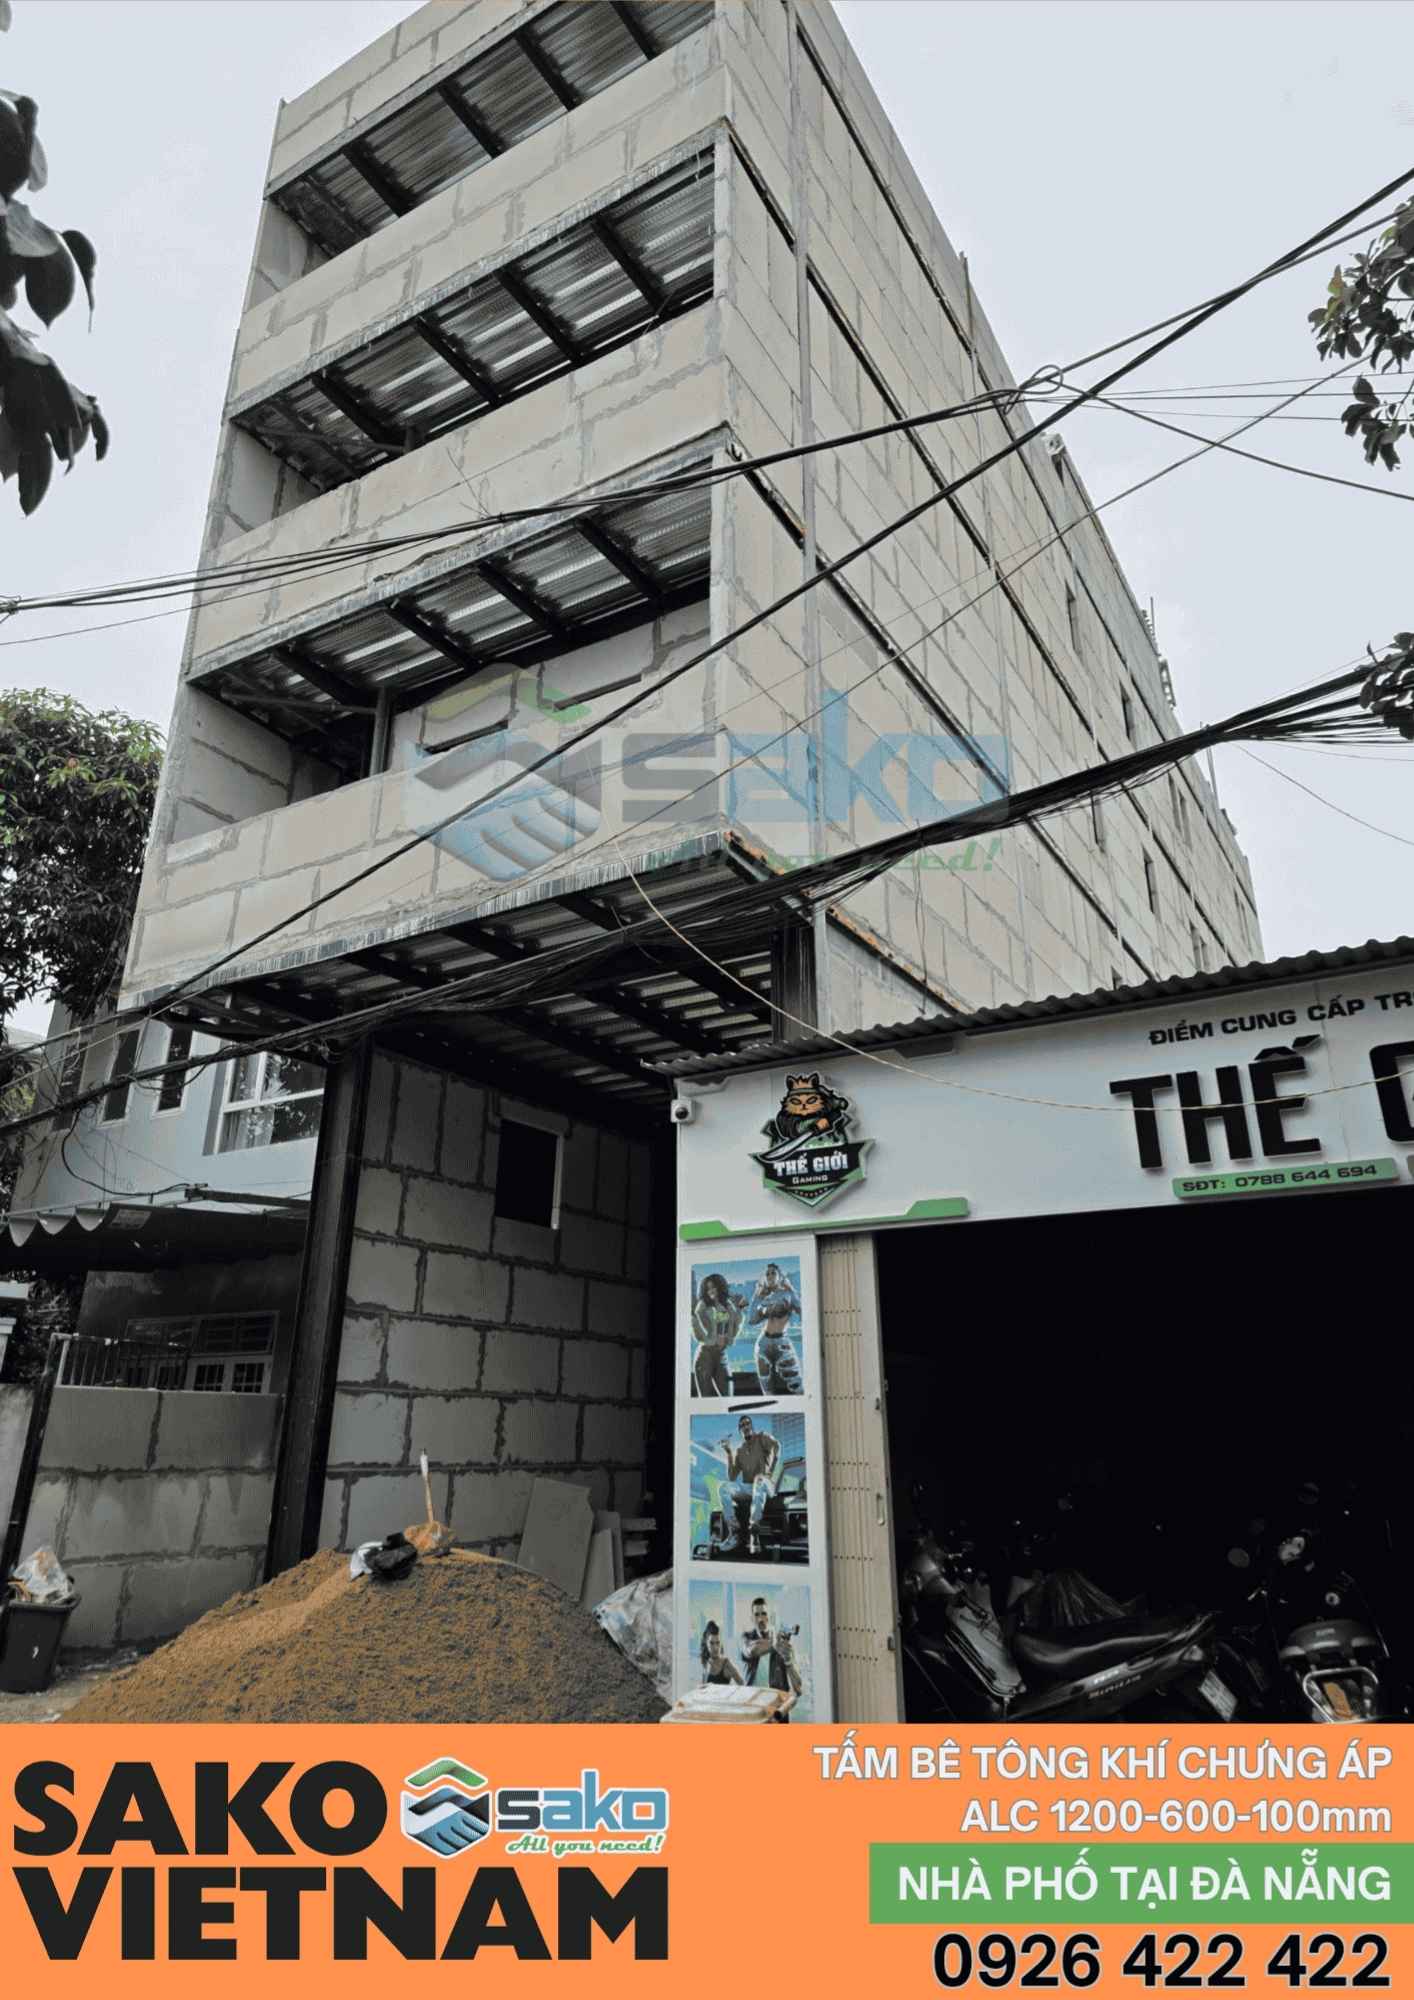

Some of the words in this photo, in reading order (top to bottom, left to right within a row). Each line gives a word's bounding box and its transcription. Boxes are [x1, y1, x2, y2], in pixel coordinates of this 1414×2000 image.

[1149, 1019, 1214, 1046] ĐIỂM
[1221, 1009, 1297, 1034] CUNG
[1307, 994, 1365, 1021] CẤP
[1109, 1034, 1321, 1168] THẾ
[773, 1152, 808, 1177] THẾ
[812, 1150, 848, 1173] GIỚI
[1182, 1179, 1226, 1193] SĐT:
[1235, 1174, 1286, 1188] 0788
[1291, 1169, 1331, 1183] 644
[1337, 1164, 1377, 1178] 694
